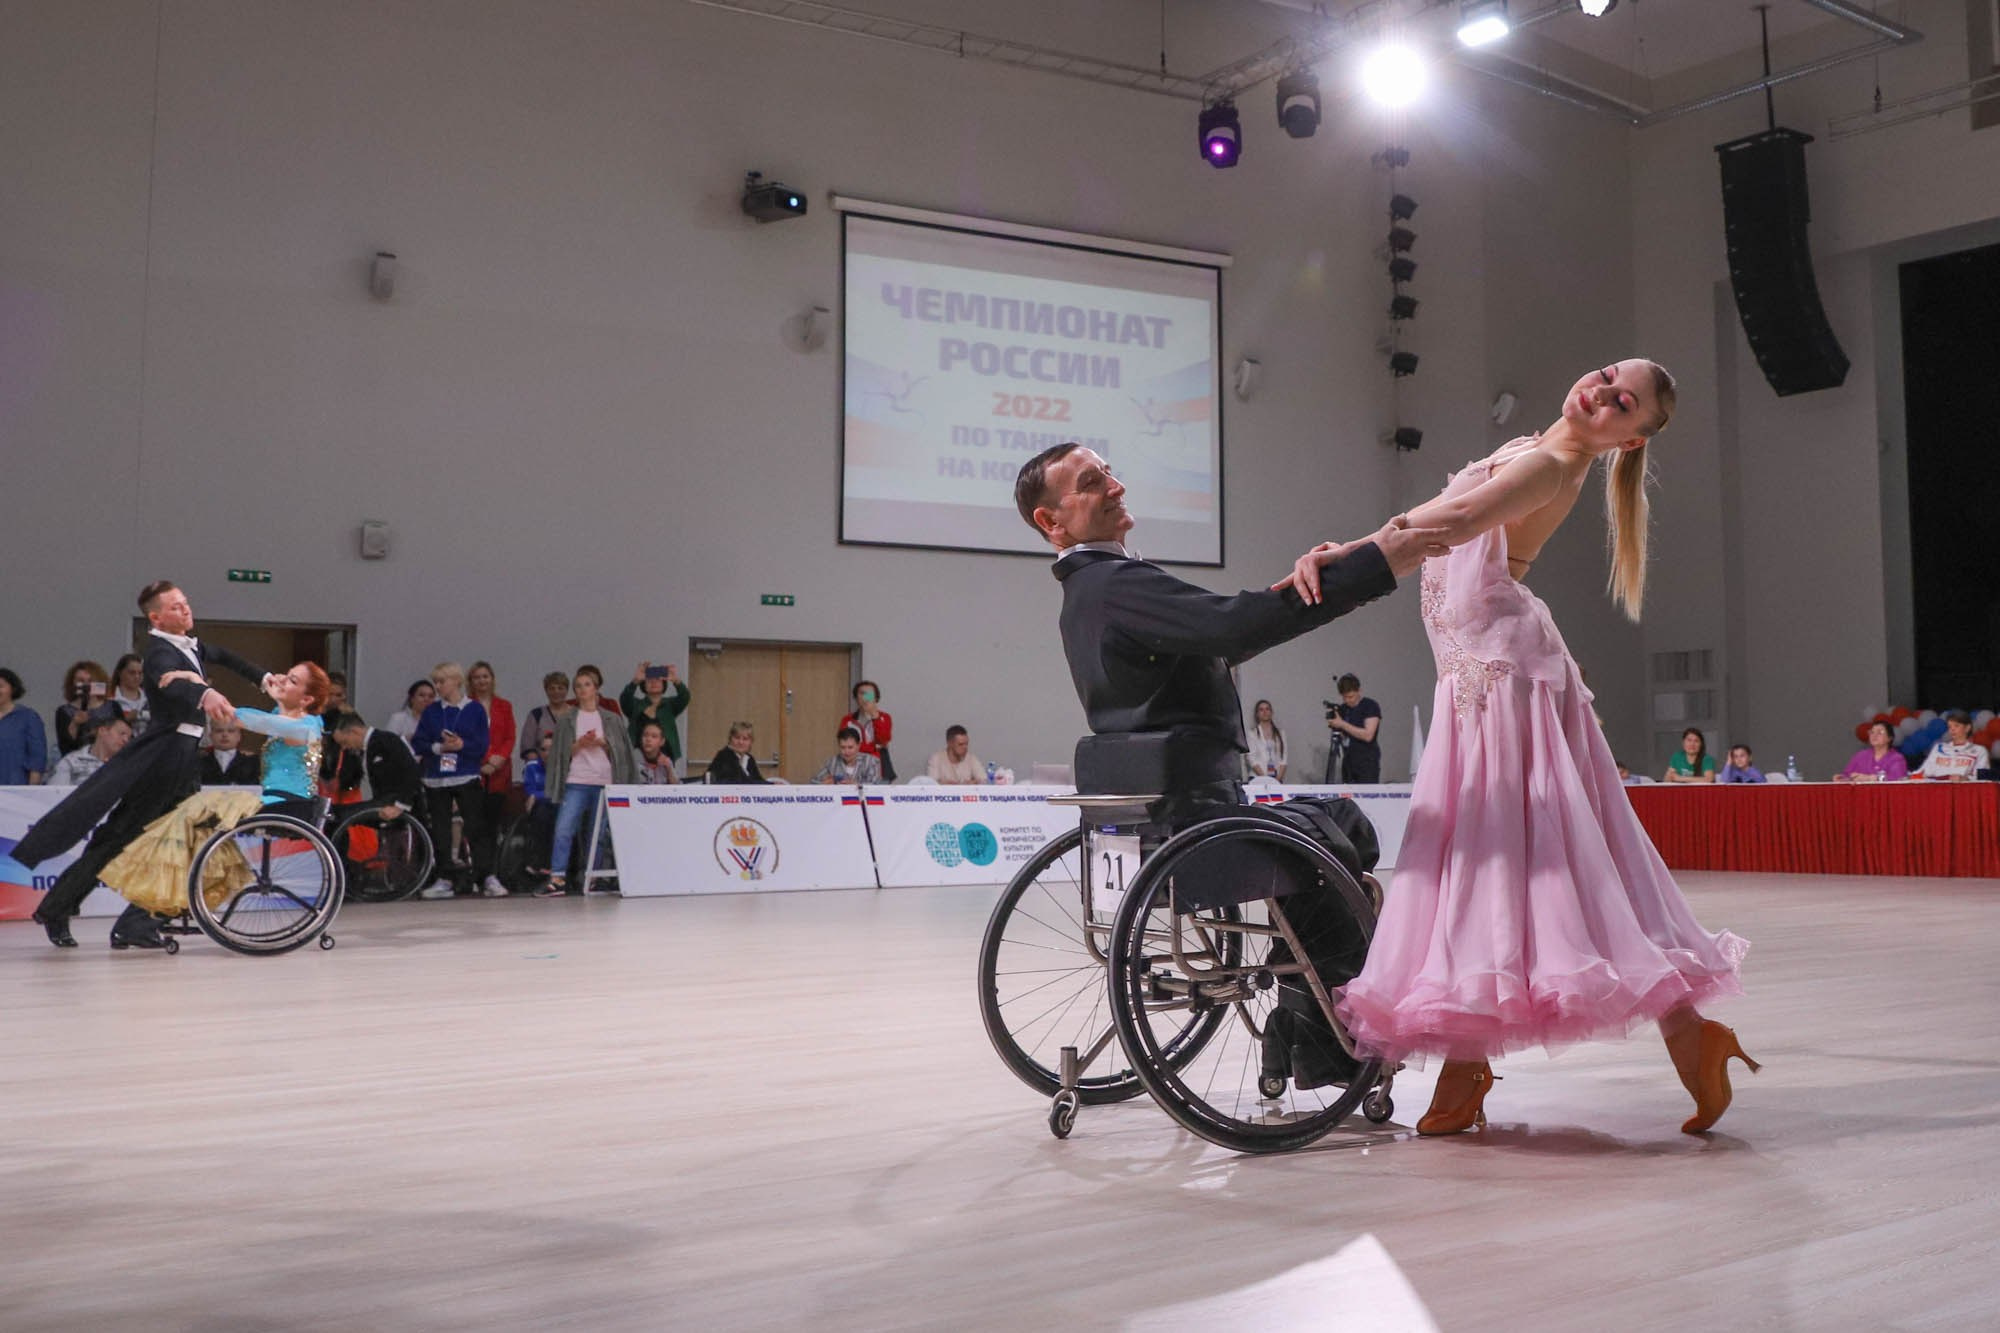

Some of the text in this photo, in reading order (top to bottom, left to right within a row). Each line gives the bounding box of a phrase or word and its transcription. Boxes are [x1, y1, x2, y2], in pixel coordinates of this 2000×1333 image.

[881, 282, 1171, 348] ЧЕМПИОНАТ
[938, 337, 1120, 389] РОССИИ
[991, 392, 1072, 423] 2022
[952, 425, 990, 446] ПО
[938, 457, 975, 477] НА
[637, 796, 686, 804] ЧЕМПИОНАТ
[689, 796, 719, 804] РОССИИ
[721, 796, 739, 804] 2022
[753, 796, 783, 804] ТАНЦАМ
[785, 795, 795, 803] НА
[796, 795, 834, 803] КОЛЯСКАХ
[891, 795, 933, 803] ЧЕМПИОНАТ
[989, 795, 1016, 803] ТАНЦАМ
[1102, 852, 1126, 891] 21
